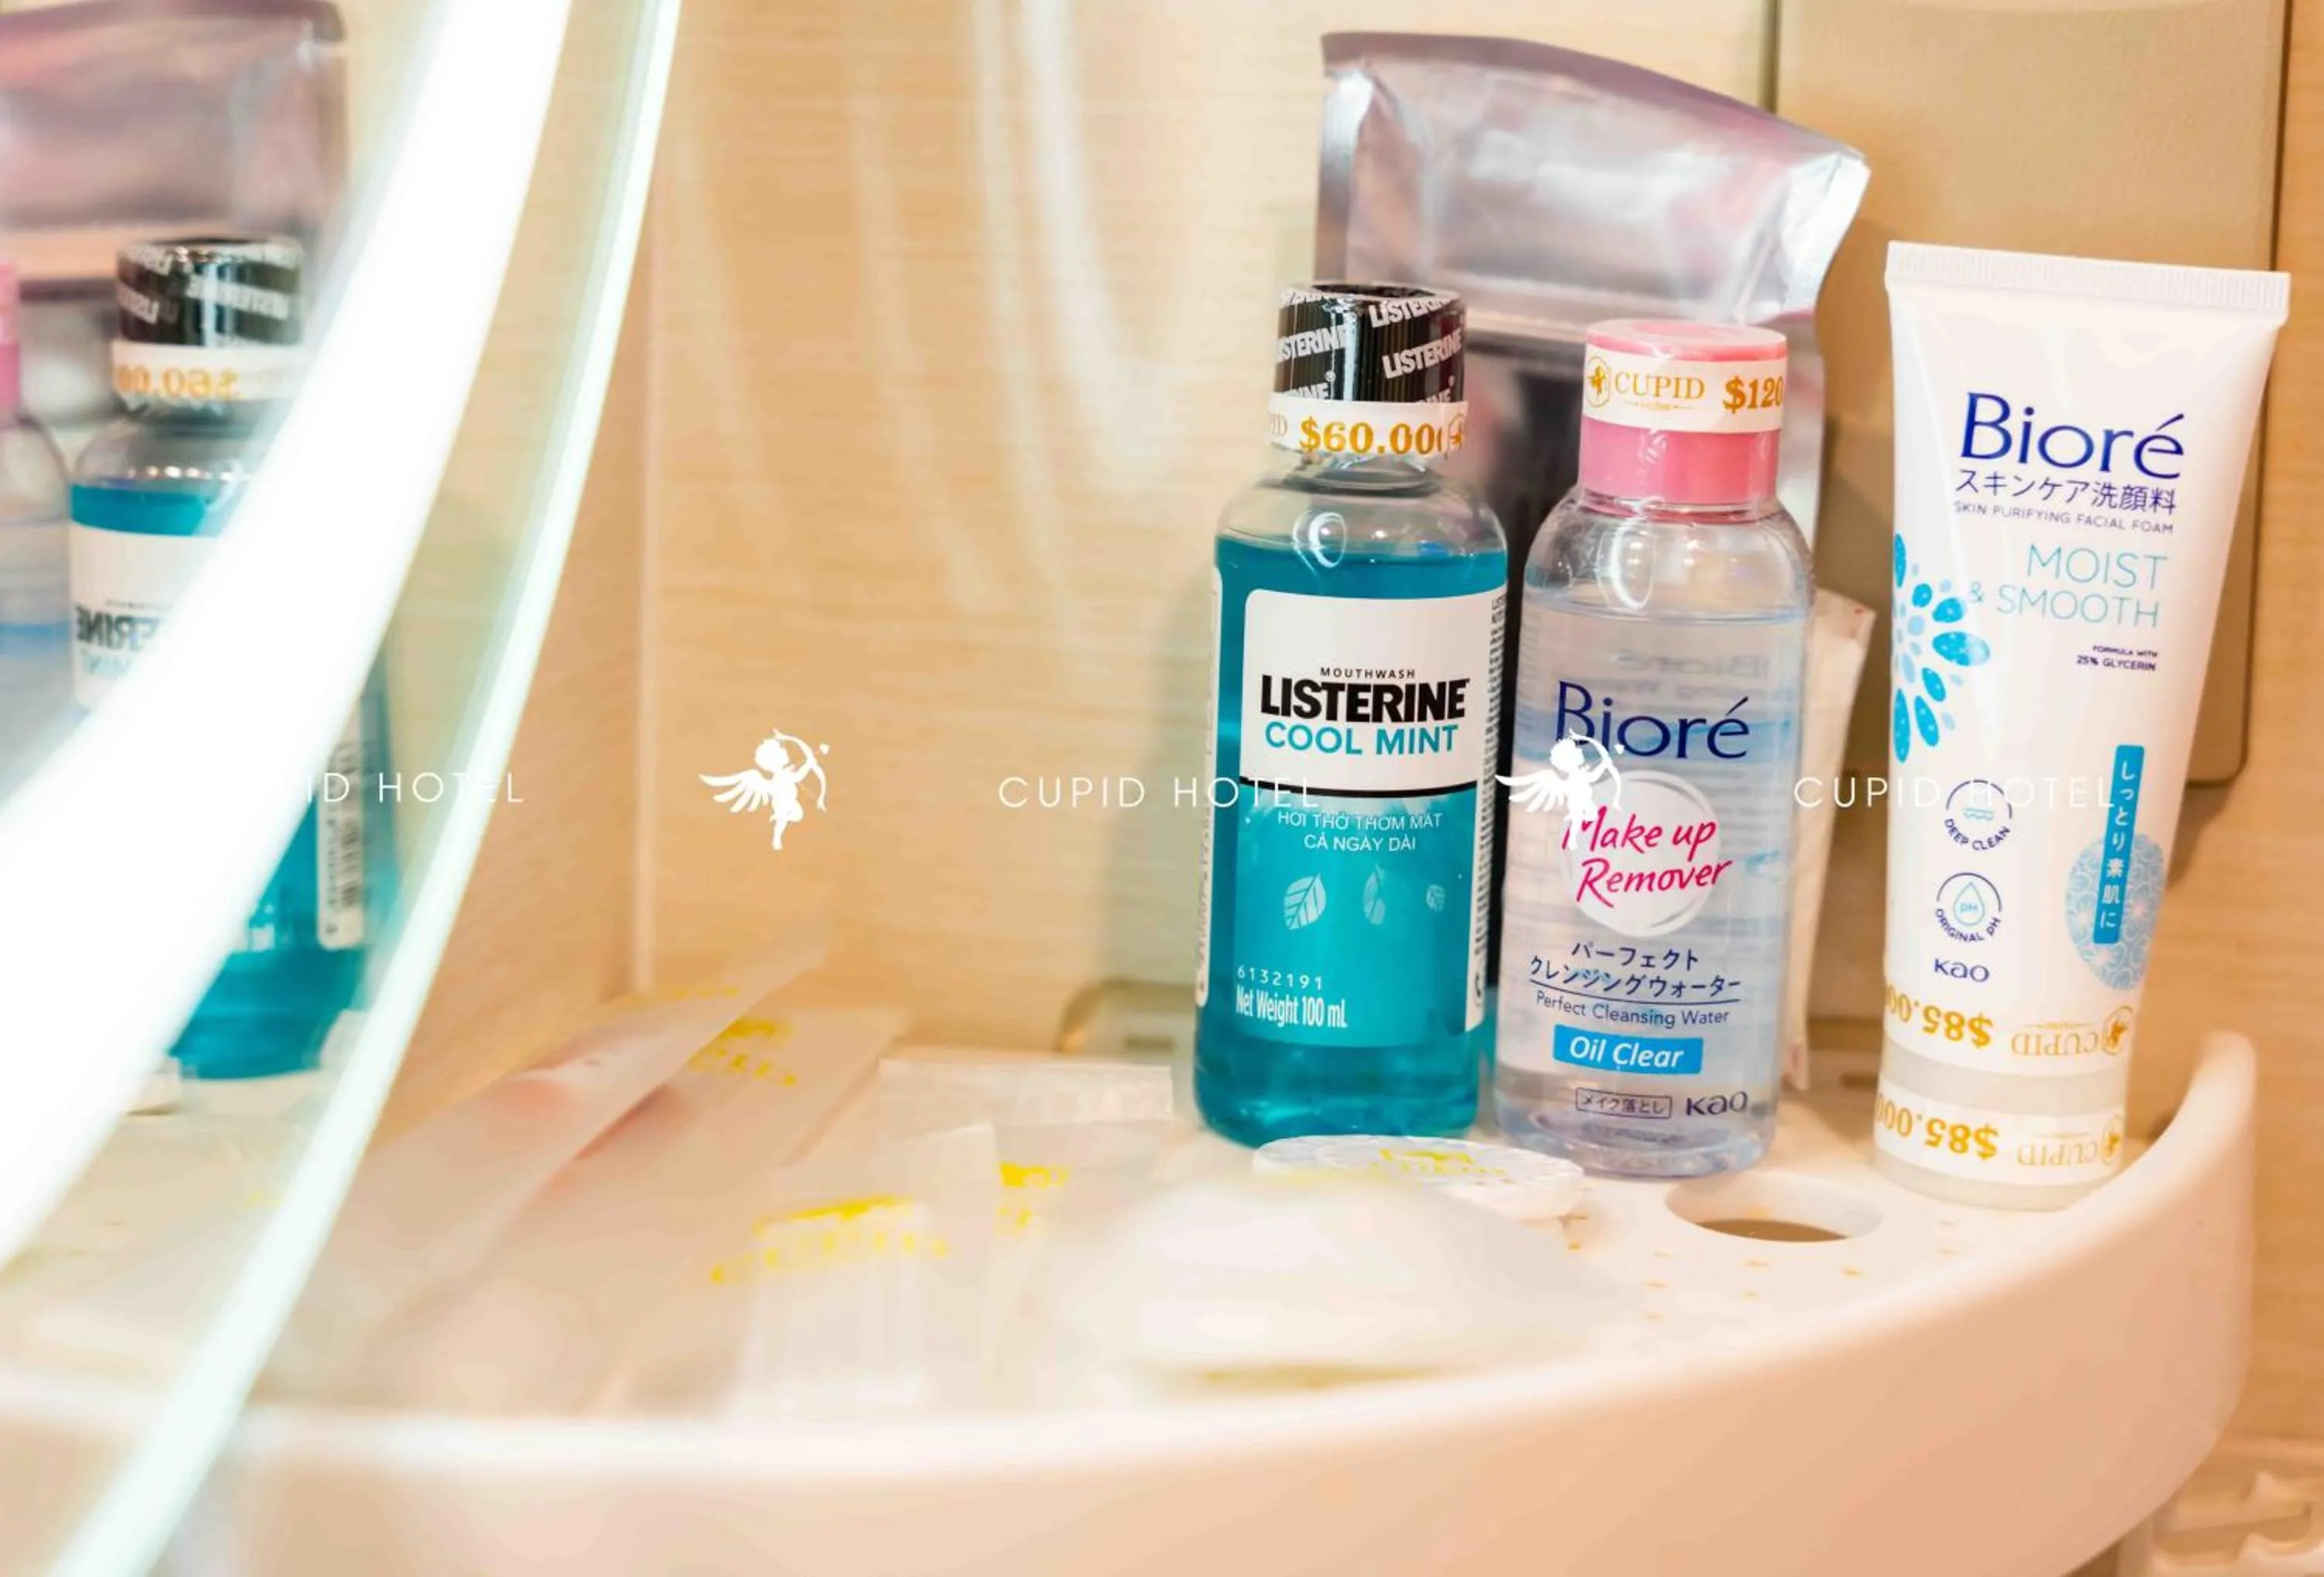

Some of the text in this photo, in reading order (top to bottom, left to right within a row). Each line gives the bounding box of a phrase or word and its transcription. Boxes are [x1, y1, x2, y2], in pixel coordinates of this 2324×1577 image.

[1382, 328, 1462, 379] LISTERINE
[1615, 371, 1705, 400] CUPID
[1299, 417, 1444, 455] $60.00
[1959, 392, 2185, 479] Bioré
[1955, 468, 2178, 515] スキンケア洗顔料
[1954, 501, 2174, 534] SKIN PURIFYING FACIAL FOAM
[2026, 544, 2168, 590] MOIST
[1996, 584, 2160, 629] SMOOTH
[2077, 655, 2156, 672] 25% GLYCERIN
[2093, 645, 2133, 655] FORMULA
[1320, 667, 1416, 679] MOUTHWASH
[1260, 675, 1470, 723] LISTERINE
[1265, 721, 1458, 754] COOL MINT
[1555, 681, 1750, 759] Bioré
[1562, 806, 1717, 861] Make up
[1944, 819, 2011, 851] DEEP CLEAN
[2100, 761, 2135, 929] しっとり素肌に
[1576, 858, 1733, 908] Remover
[1935, 908, 1985, 943] ORIGINAL
[1571, 942, 1699, 971] パーフェクト
[1237, 965, 1322, 991] 6132191
[1531, 955, 1741, 998] クレンジングウォーター
[1236, 984, 1348, 1028] Net Weight 100 mL
[1537, 990, 1729, 1029] Perfect Cleansing Water
[1570, 1036, 1684, 1067] Oil Clear
[2011, 1032, 2098, 1056] CUPID
[1583, 1095, 1665, 1114] メイク落とし
[2016, 1140, 2099, 1166] CUPID
